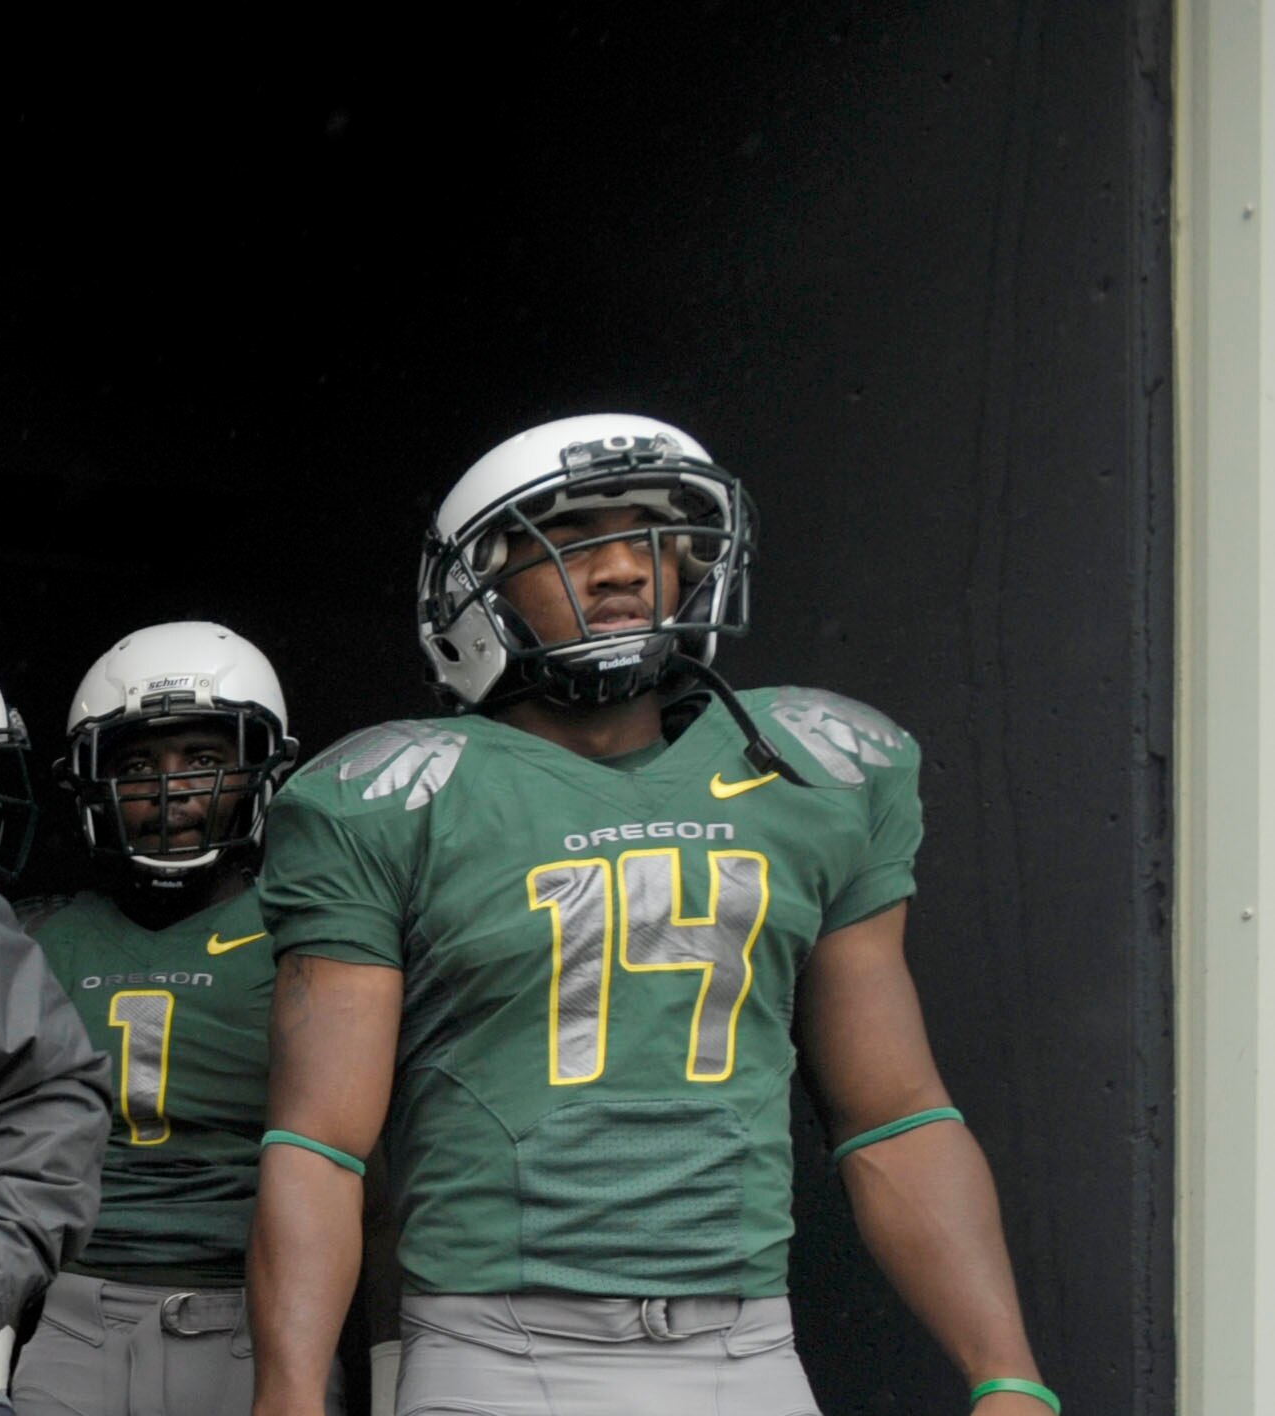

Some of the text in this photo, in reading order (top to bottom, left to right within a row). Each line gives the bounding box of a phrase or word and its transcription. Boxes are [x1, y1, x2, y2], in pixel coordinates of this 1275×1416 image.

[564, 822, 735, 851] OREGON
[82, 972, 213, 989] OREGON
[526, 848, 769, 1086] 14
[109, 989, 175, 1146] 1
